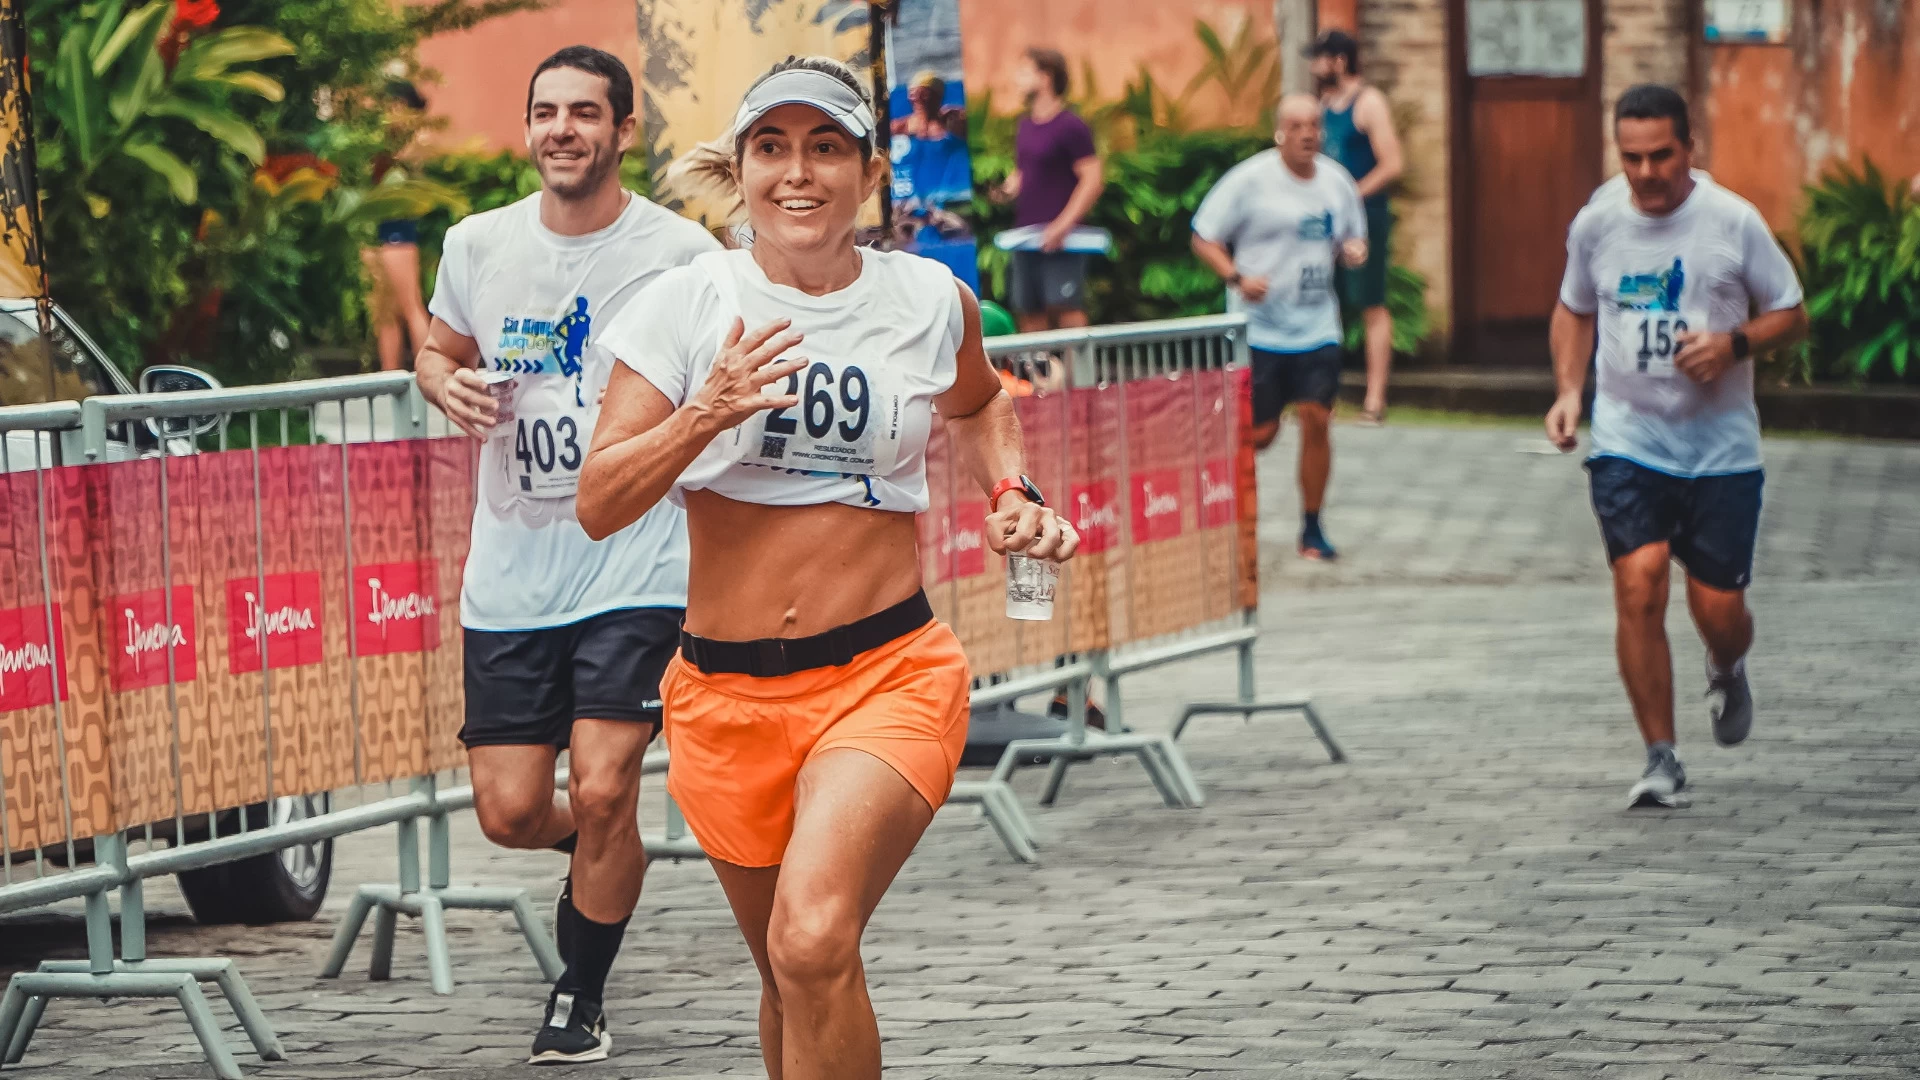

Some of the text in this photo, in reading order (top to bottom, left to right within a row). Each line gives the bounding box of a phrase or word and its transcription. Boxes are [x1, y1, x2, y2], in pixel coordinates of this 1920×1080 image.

[764, 359, 870, 443] 269
[516, 416, 582, 474] 403
[368, 577, 438, 640] Ipanema
[0, 642, 51, 696] panema
